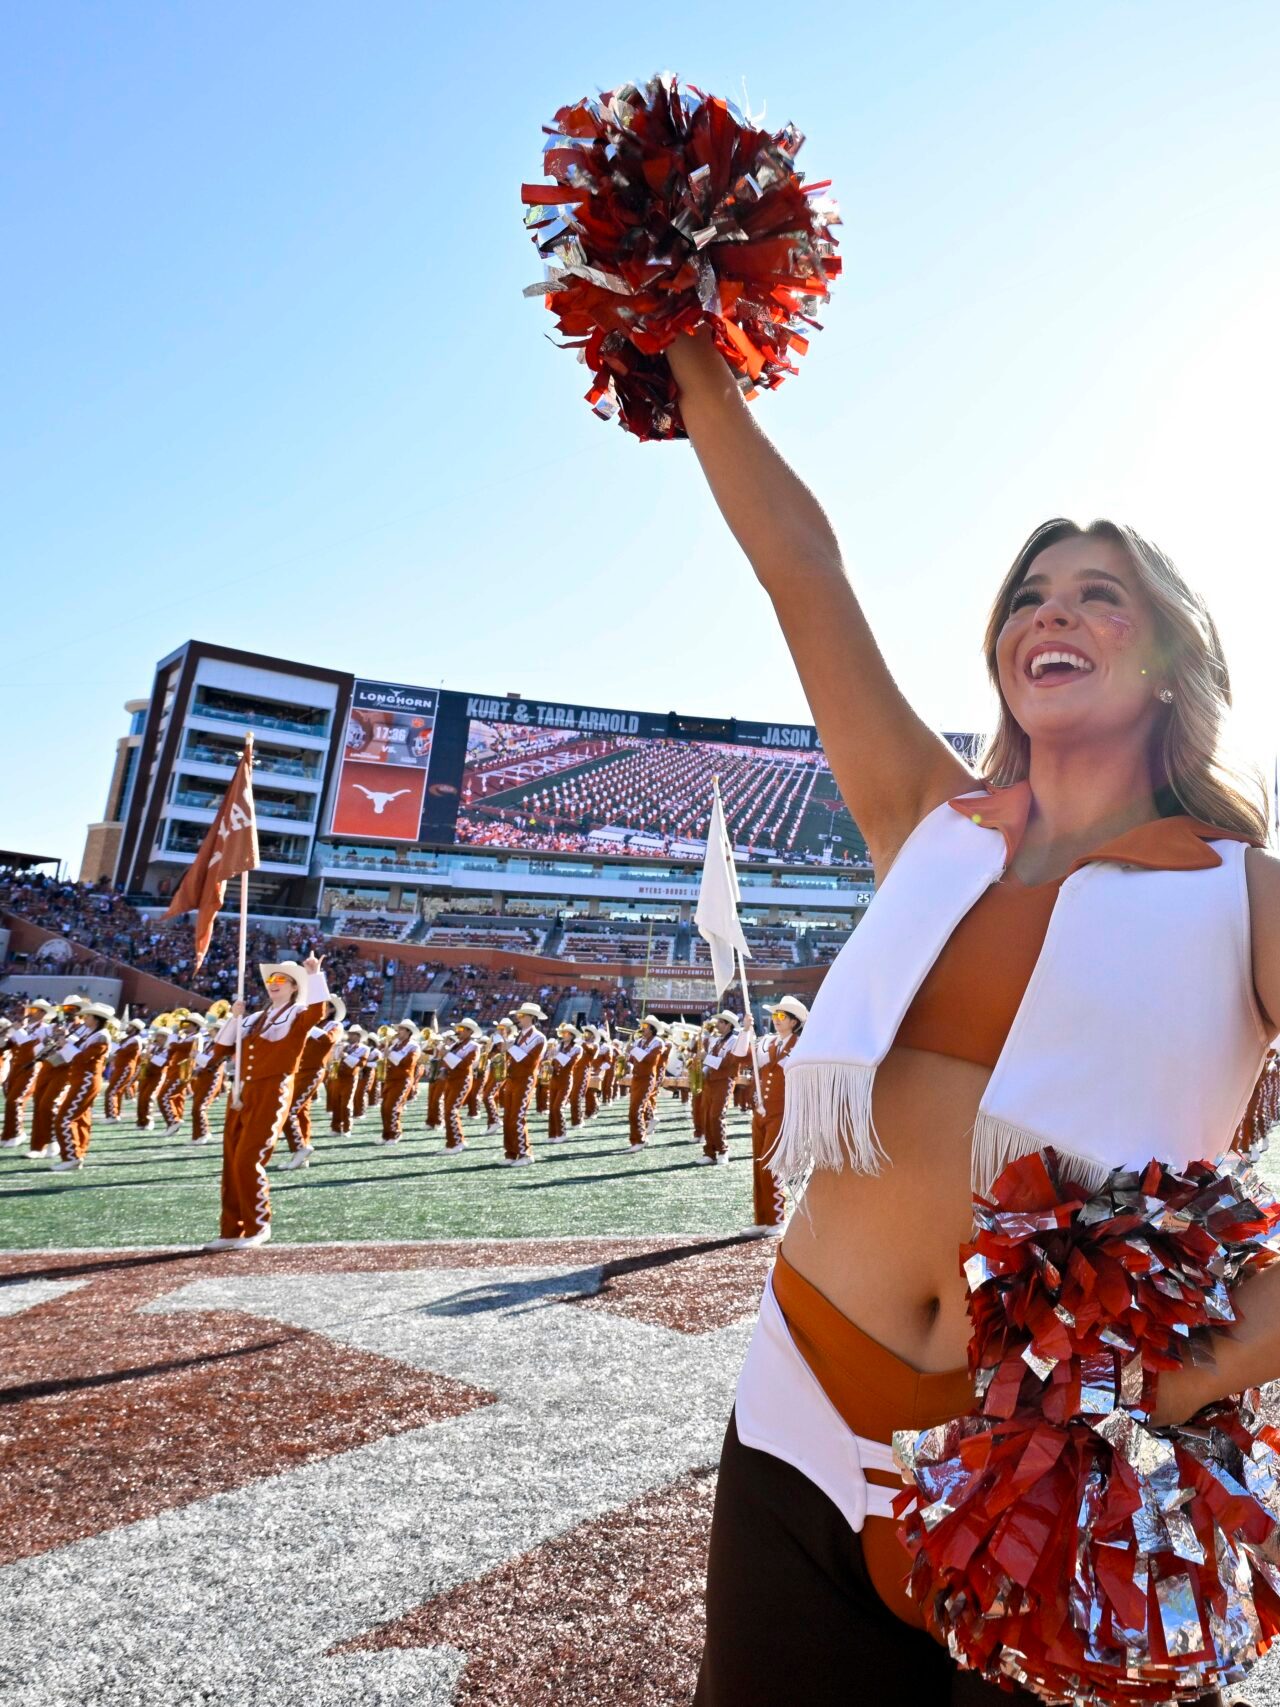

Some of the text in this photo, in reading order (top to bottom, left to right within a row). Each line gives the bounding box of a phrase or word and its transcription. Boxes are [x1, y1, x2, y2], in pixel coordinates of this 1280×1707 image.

[360, 692, 432, 708] LONGHORN
[466, 698, 639, 734] KURT & TARA ARNOLD
[376, 726, 407, 741] 17:36
[762, 727, 811, 748] JASON
[857, 893, 870, 903] 25
